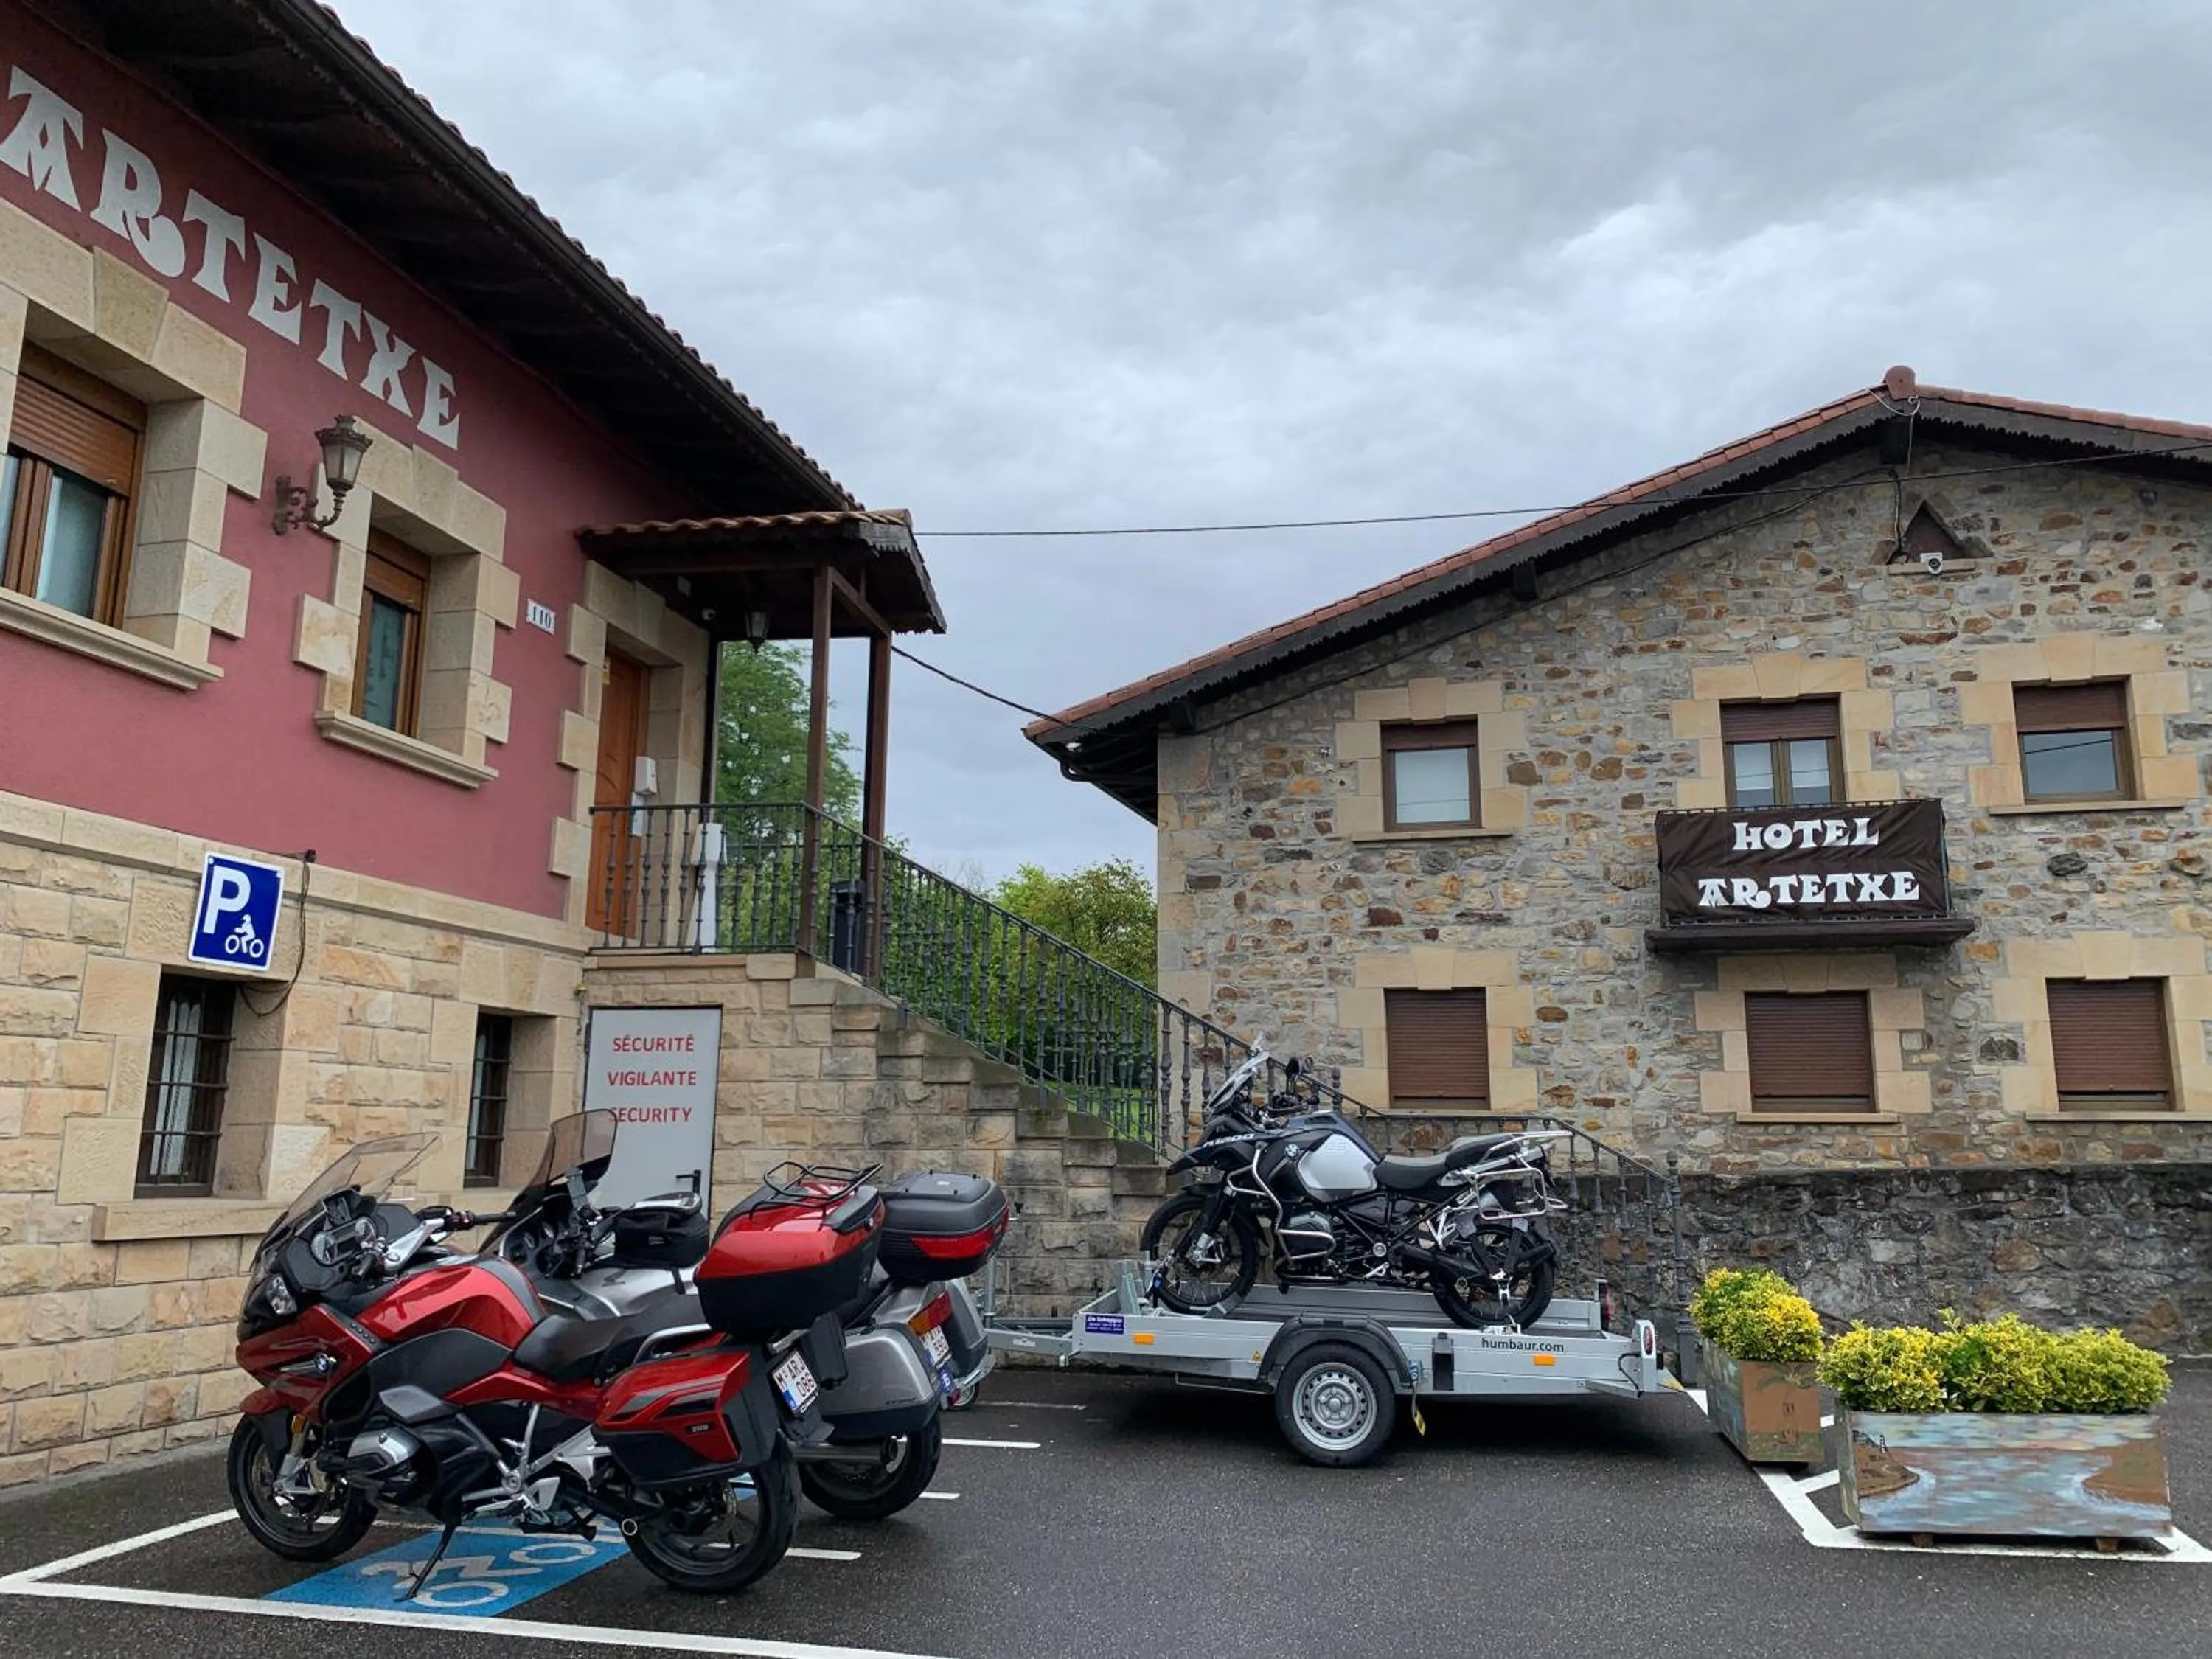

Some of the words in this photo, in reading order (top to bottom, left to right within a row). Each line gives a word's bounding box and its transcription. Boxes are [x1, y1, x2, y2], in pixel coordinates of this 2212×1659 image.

[0, 64, 460, 451] ARTETXE
[532, 605, 552, 628] 110
[1732, 817, 1880, 851] HOTEL
[202, 865, 251, 935] P
[1697, 870, 1920, 909] ARTETXE
[613, 1034, 695, 1053] SÉCURITÉ
[607, 1071, 698, 1087] VIGILANTE
[610, 1107, 693, 1123] SECURITY
[1481, 1337, 1564, 1352] humbaur.com
